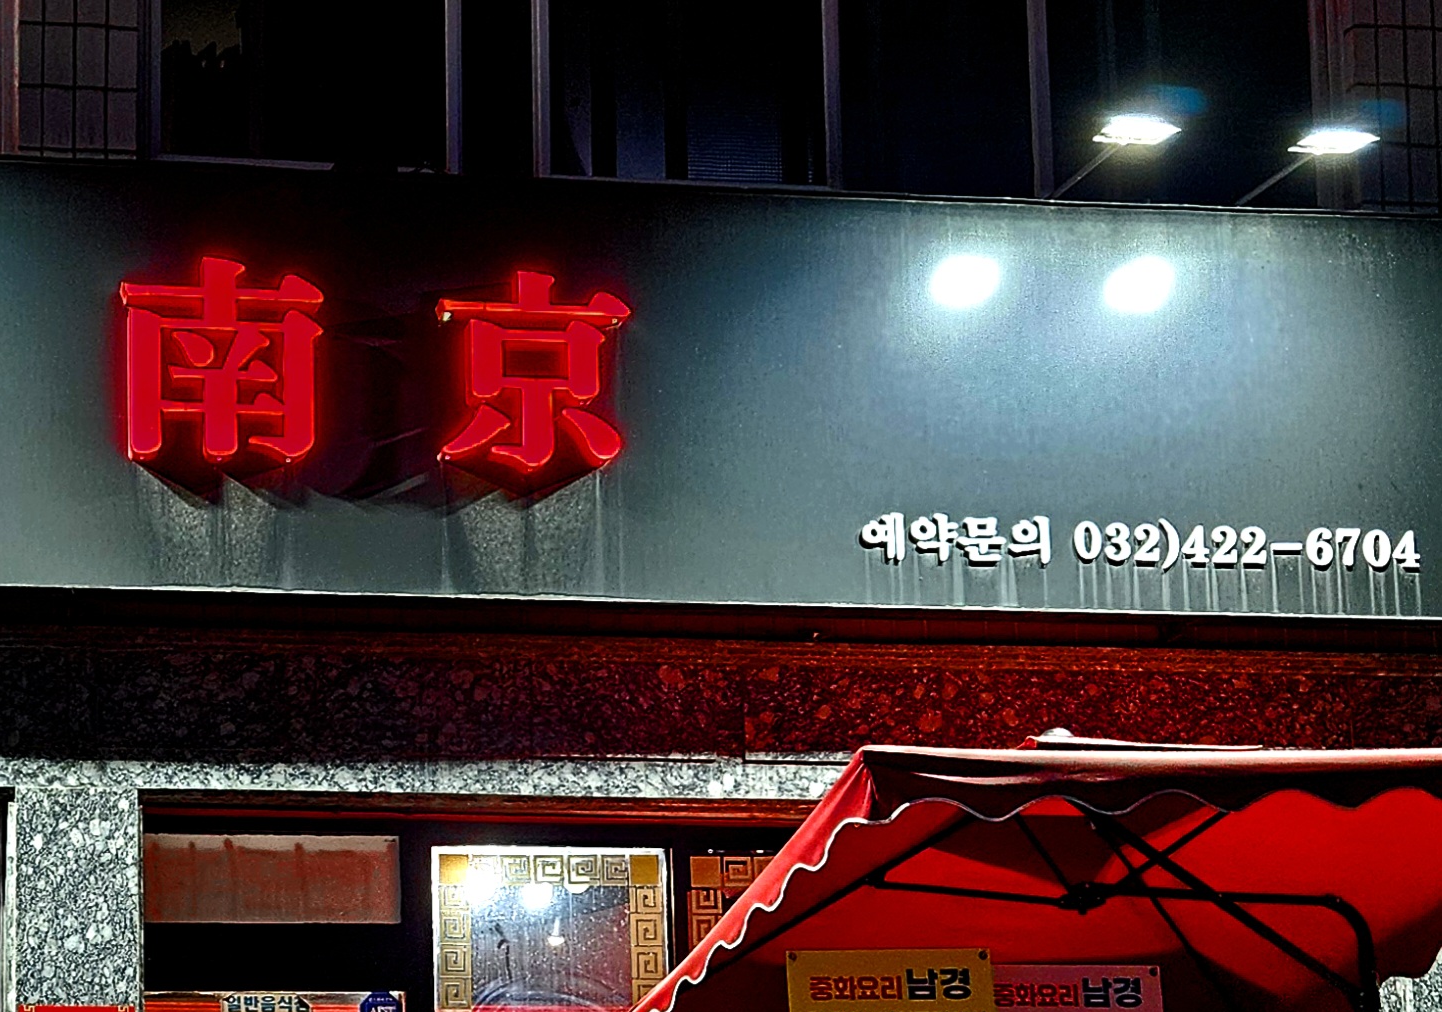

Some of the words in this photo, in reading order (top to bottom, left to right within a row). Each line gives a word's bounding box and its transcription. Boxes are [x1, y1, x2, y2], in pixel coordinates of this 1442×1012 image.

[119, 257, 632, 468] 南京
[861, 512, 1052, 565] 예약문의
[1074, 518, 1421, 570] 032)422-6704
[809, 975, 902, 1000] 중화요리
[905, 967, 972, 1000] 남경
[993, 983, 1079, 1007] 중화요리
[1082, 977, 1143, 1008] 남경
